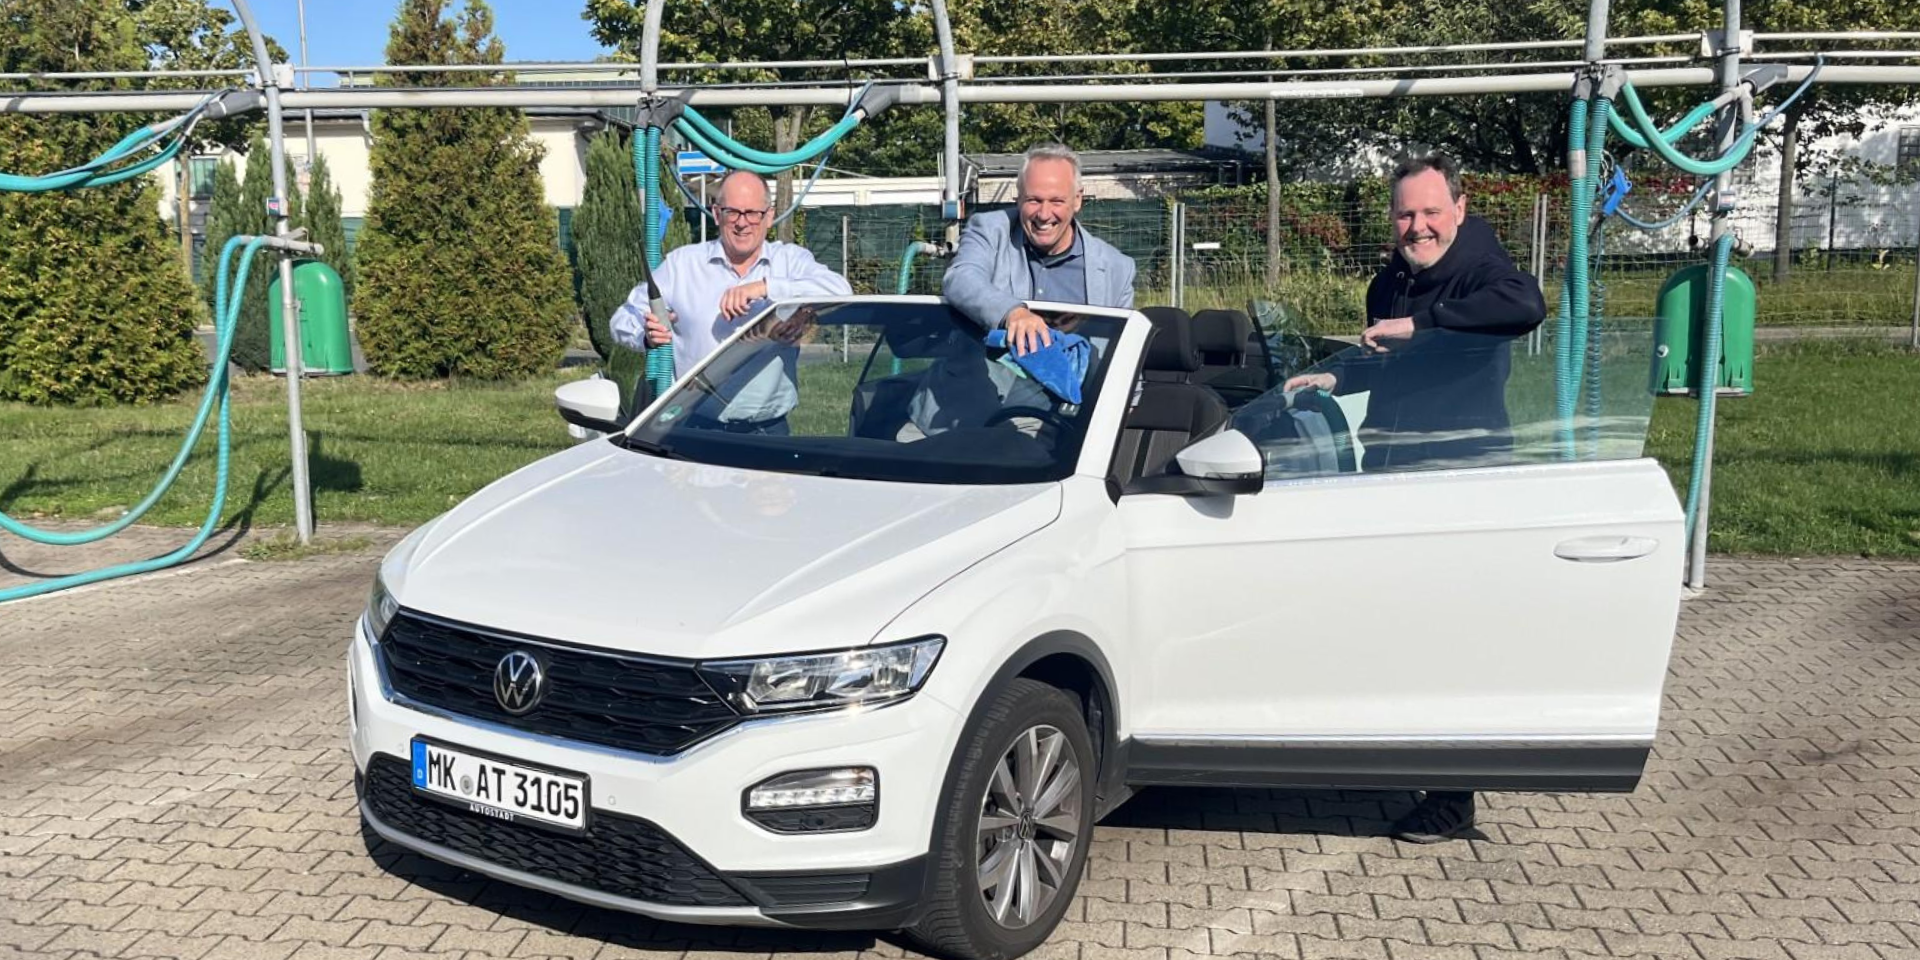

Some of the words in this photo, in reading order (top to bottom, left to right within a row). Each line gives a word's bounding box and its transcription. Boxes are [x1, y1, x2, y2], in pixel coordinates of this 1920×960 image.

[499, 654, 536, 707] VW
[417, 769, 423, 779] D
[428, 750, 456, 790] MK
[477, 764, 505, 802] AT
[514, 772, 579, 820] 3105
[469, 802, 514, 821] AUTOSTADT
